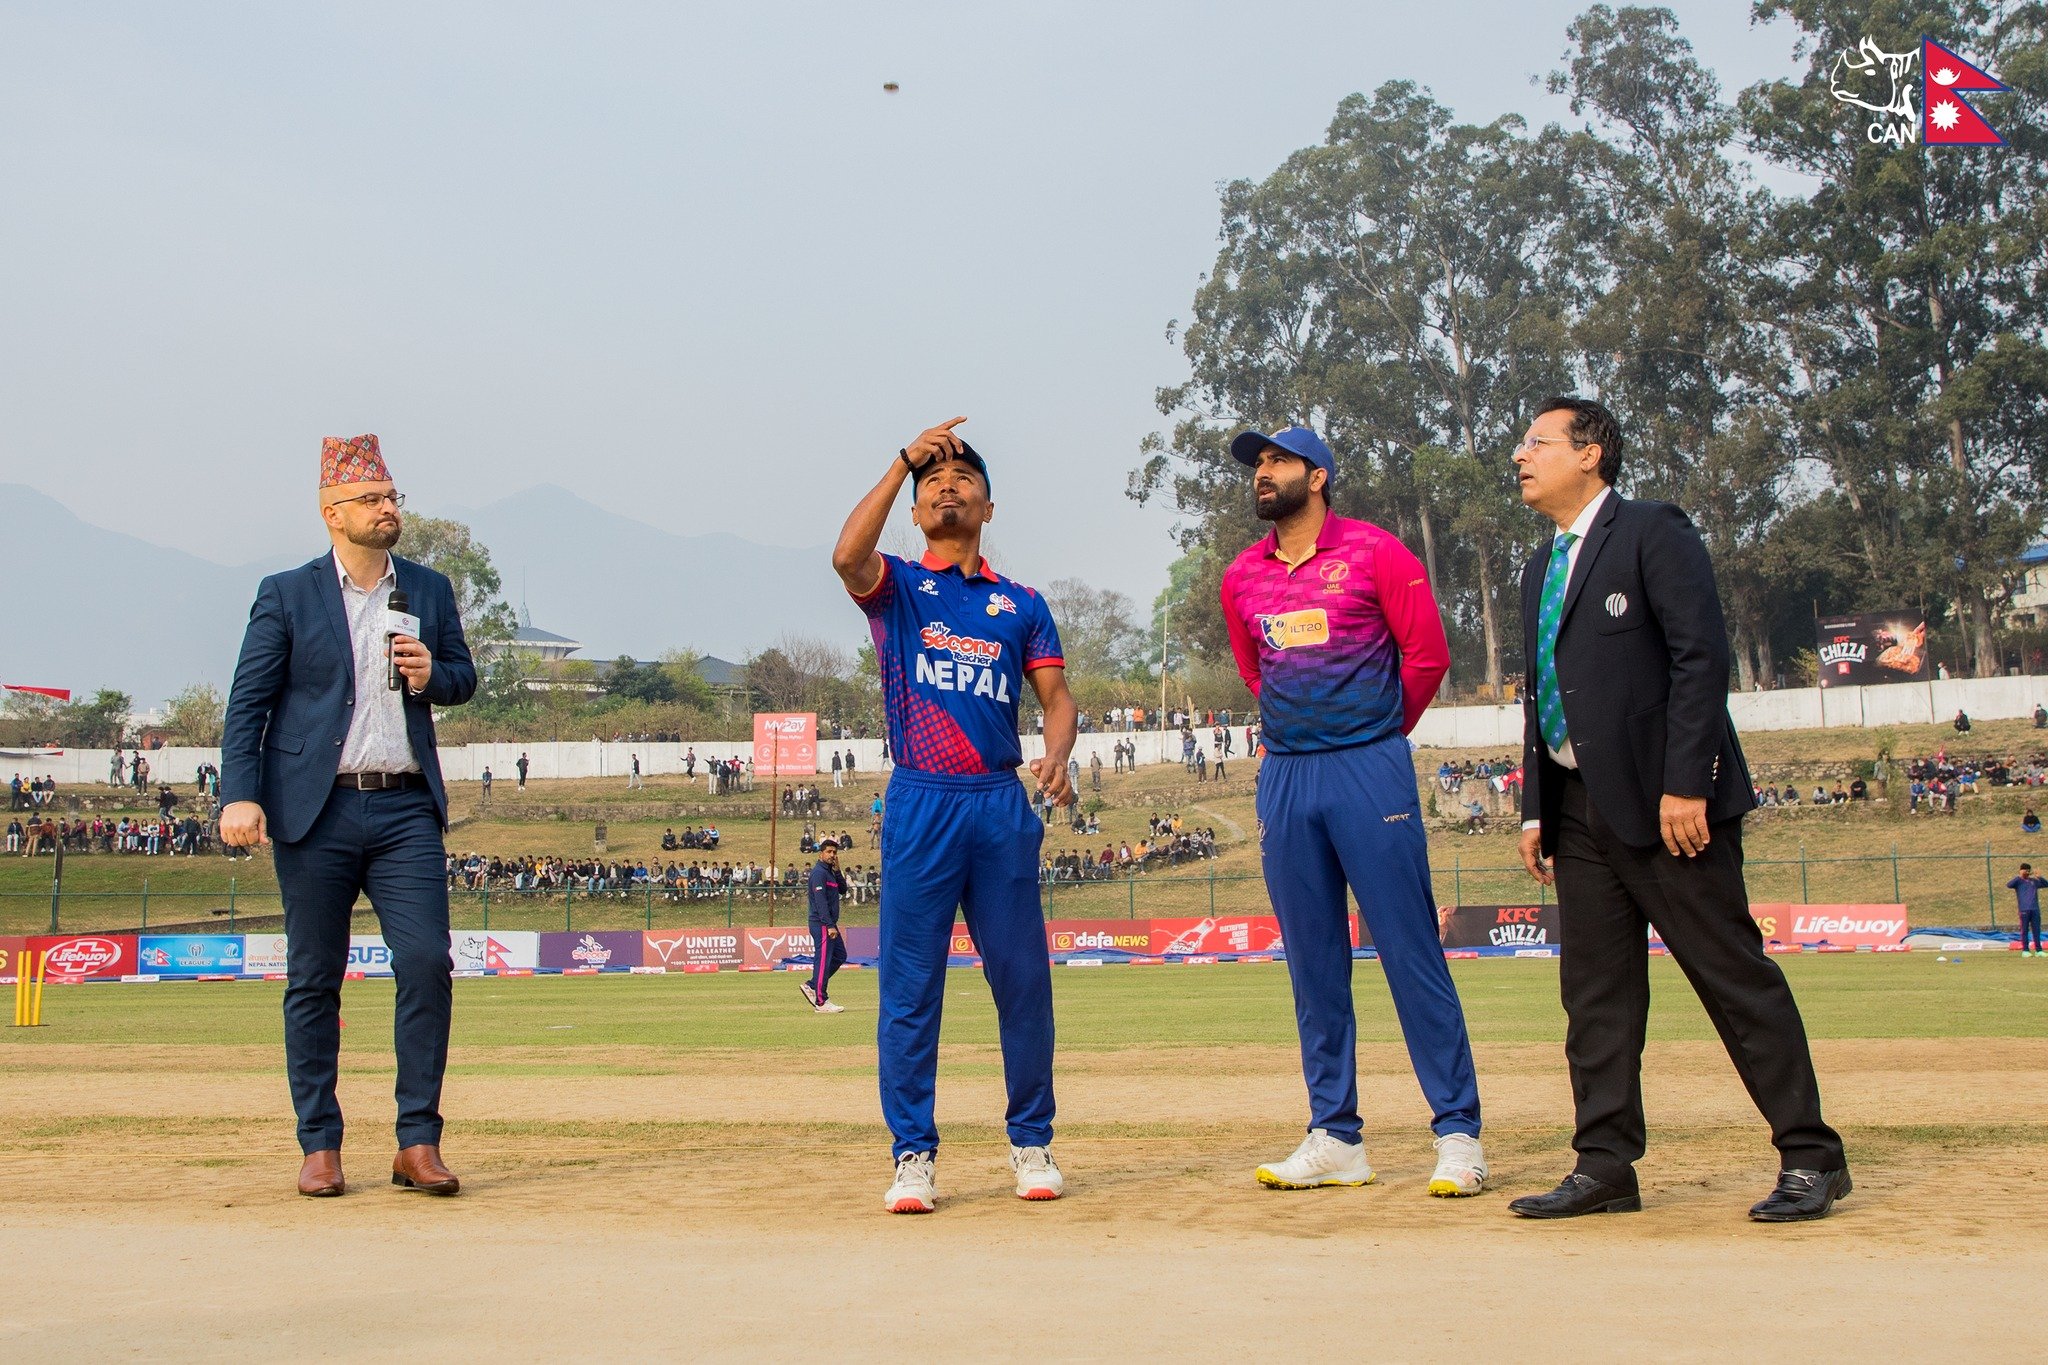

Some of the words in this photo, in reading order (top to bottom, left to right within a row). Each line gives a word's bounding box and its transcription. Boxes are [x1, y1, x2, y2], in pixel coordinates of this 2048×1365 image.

[930, 622, 951, 635] My
[1290, 622, 1322, 633] ILT20
[920, 627, 1002, 660] Second
[951, 650, 992, 667] Teacher
[1819, 642, 1866, 662] CHIZZA
[916, 653, 1010, 703] NEPAL
[764, 718, 806, 732] MyPay
[1496, 907, 1541, 923] KFC
[1792, 916, 1904, 936] Lifebuoy
[685, 935, 737, 949] UNITED
[787, 935, 815, 946] UNI
[1488, 923, 1547, 946] CHIZZA
[50, 951, 113, 963] Lifebuoy
[348, 946, 393, 964] SUB
[469, 961, 484, 969] CAN
